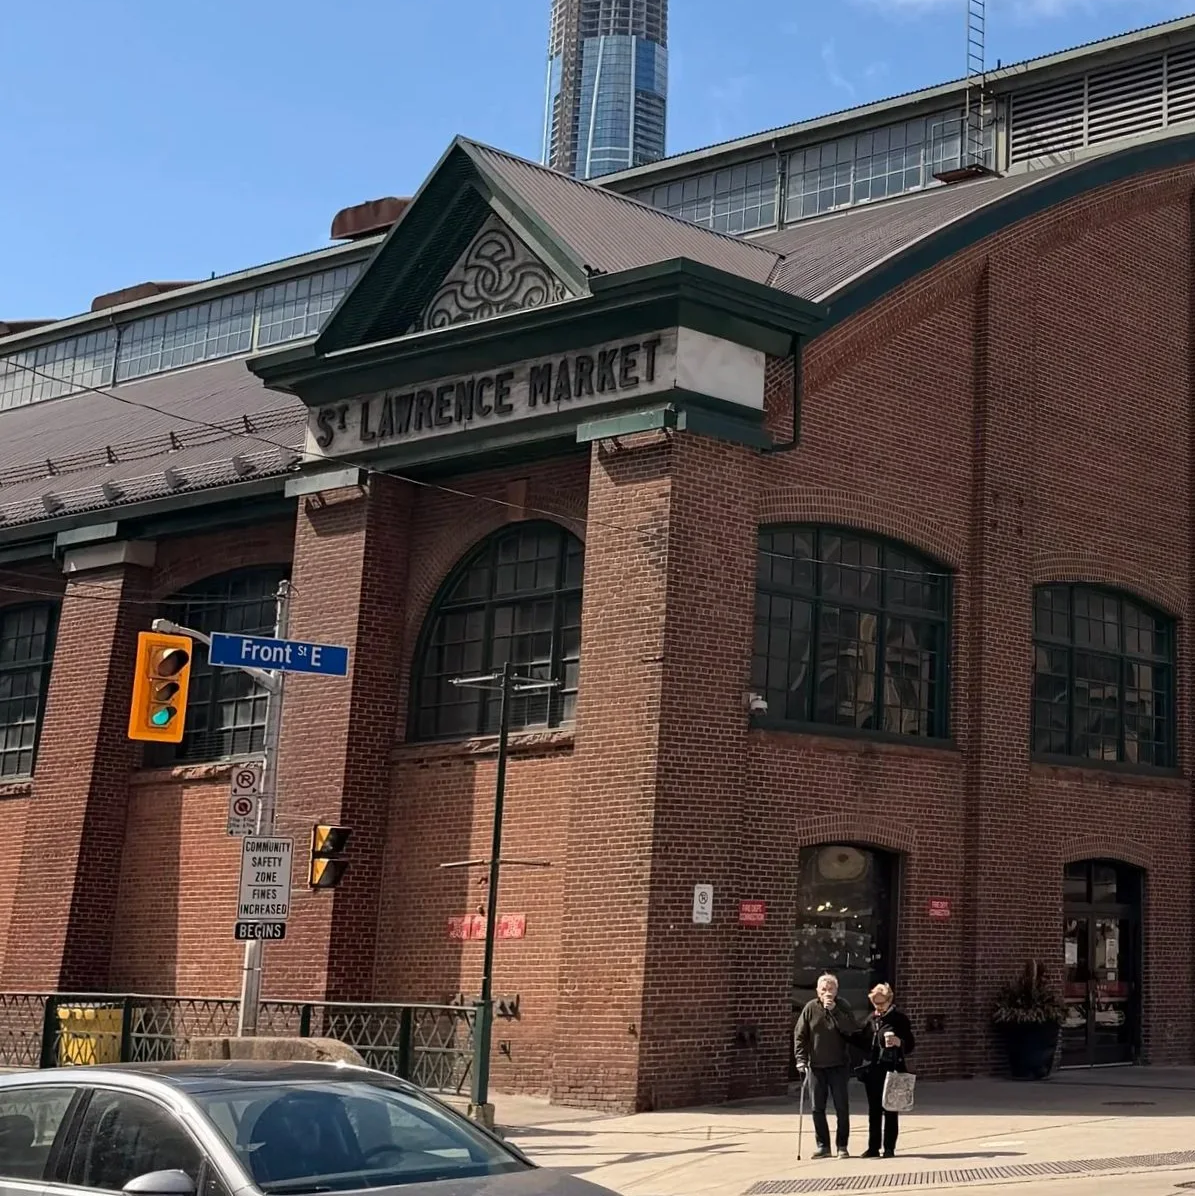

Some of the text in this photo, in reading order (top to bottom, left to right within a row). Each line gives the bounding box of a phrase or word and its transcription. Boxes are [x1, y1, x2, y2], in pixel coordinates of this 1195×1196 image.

[360, 370, 515, 442] LAWRENCE
[528, 335, 661, 407] MARKET
[240, 639, 322, 667] Front St E
[245, 841, 290, 853] COMMUNITY
[251, 856, 282, 867] SAFETY
[255, 871, 277, 883] ZONE
[252, 889, 277, 900] FINES
[240, 904, 287, 915] INCREASED
[239, 924, 281, 939] BEGINS
